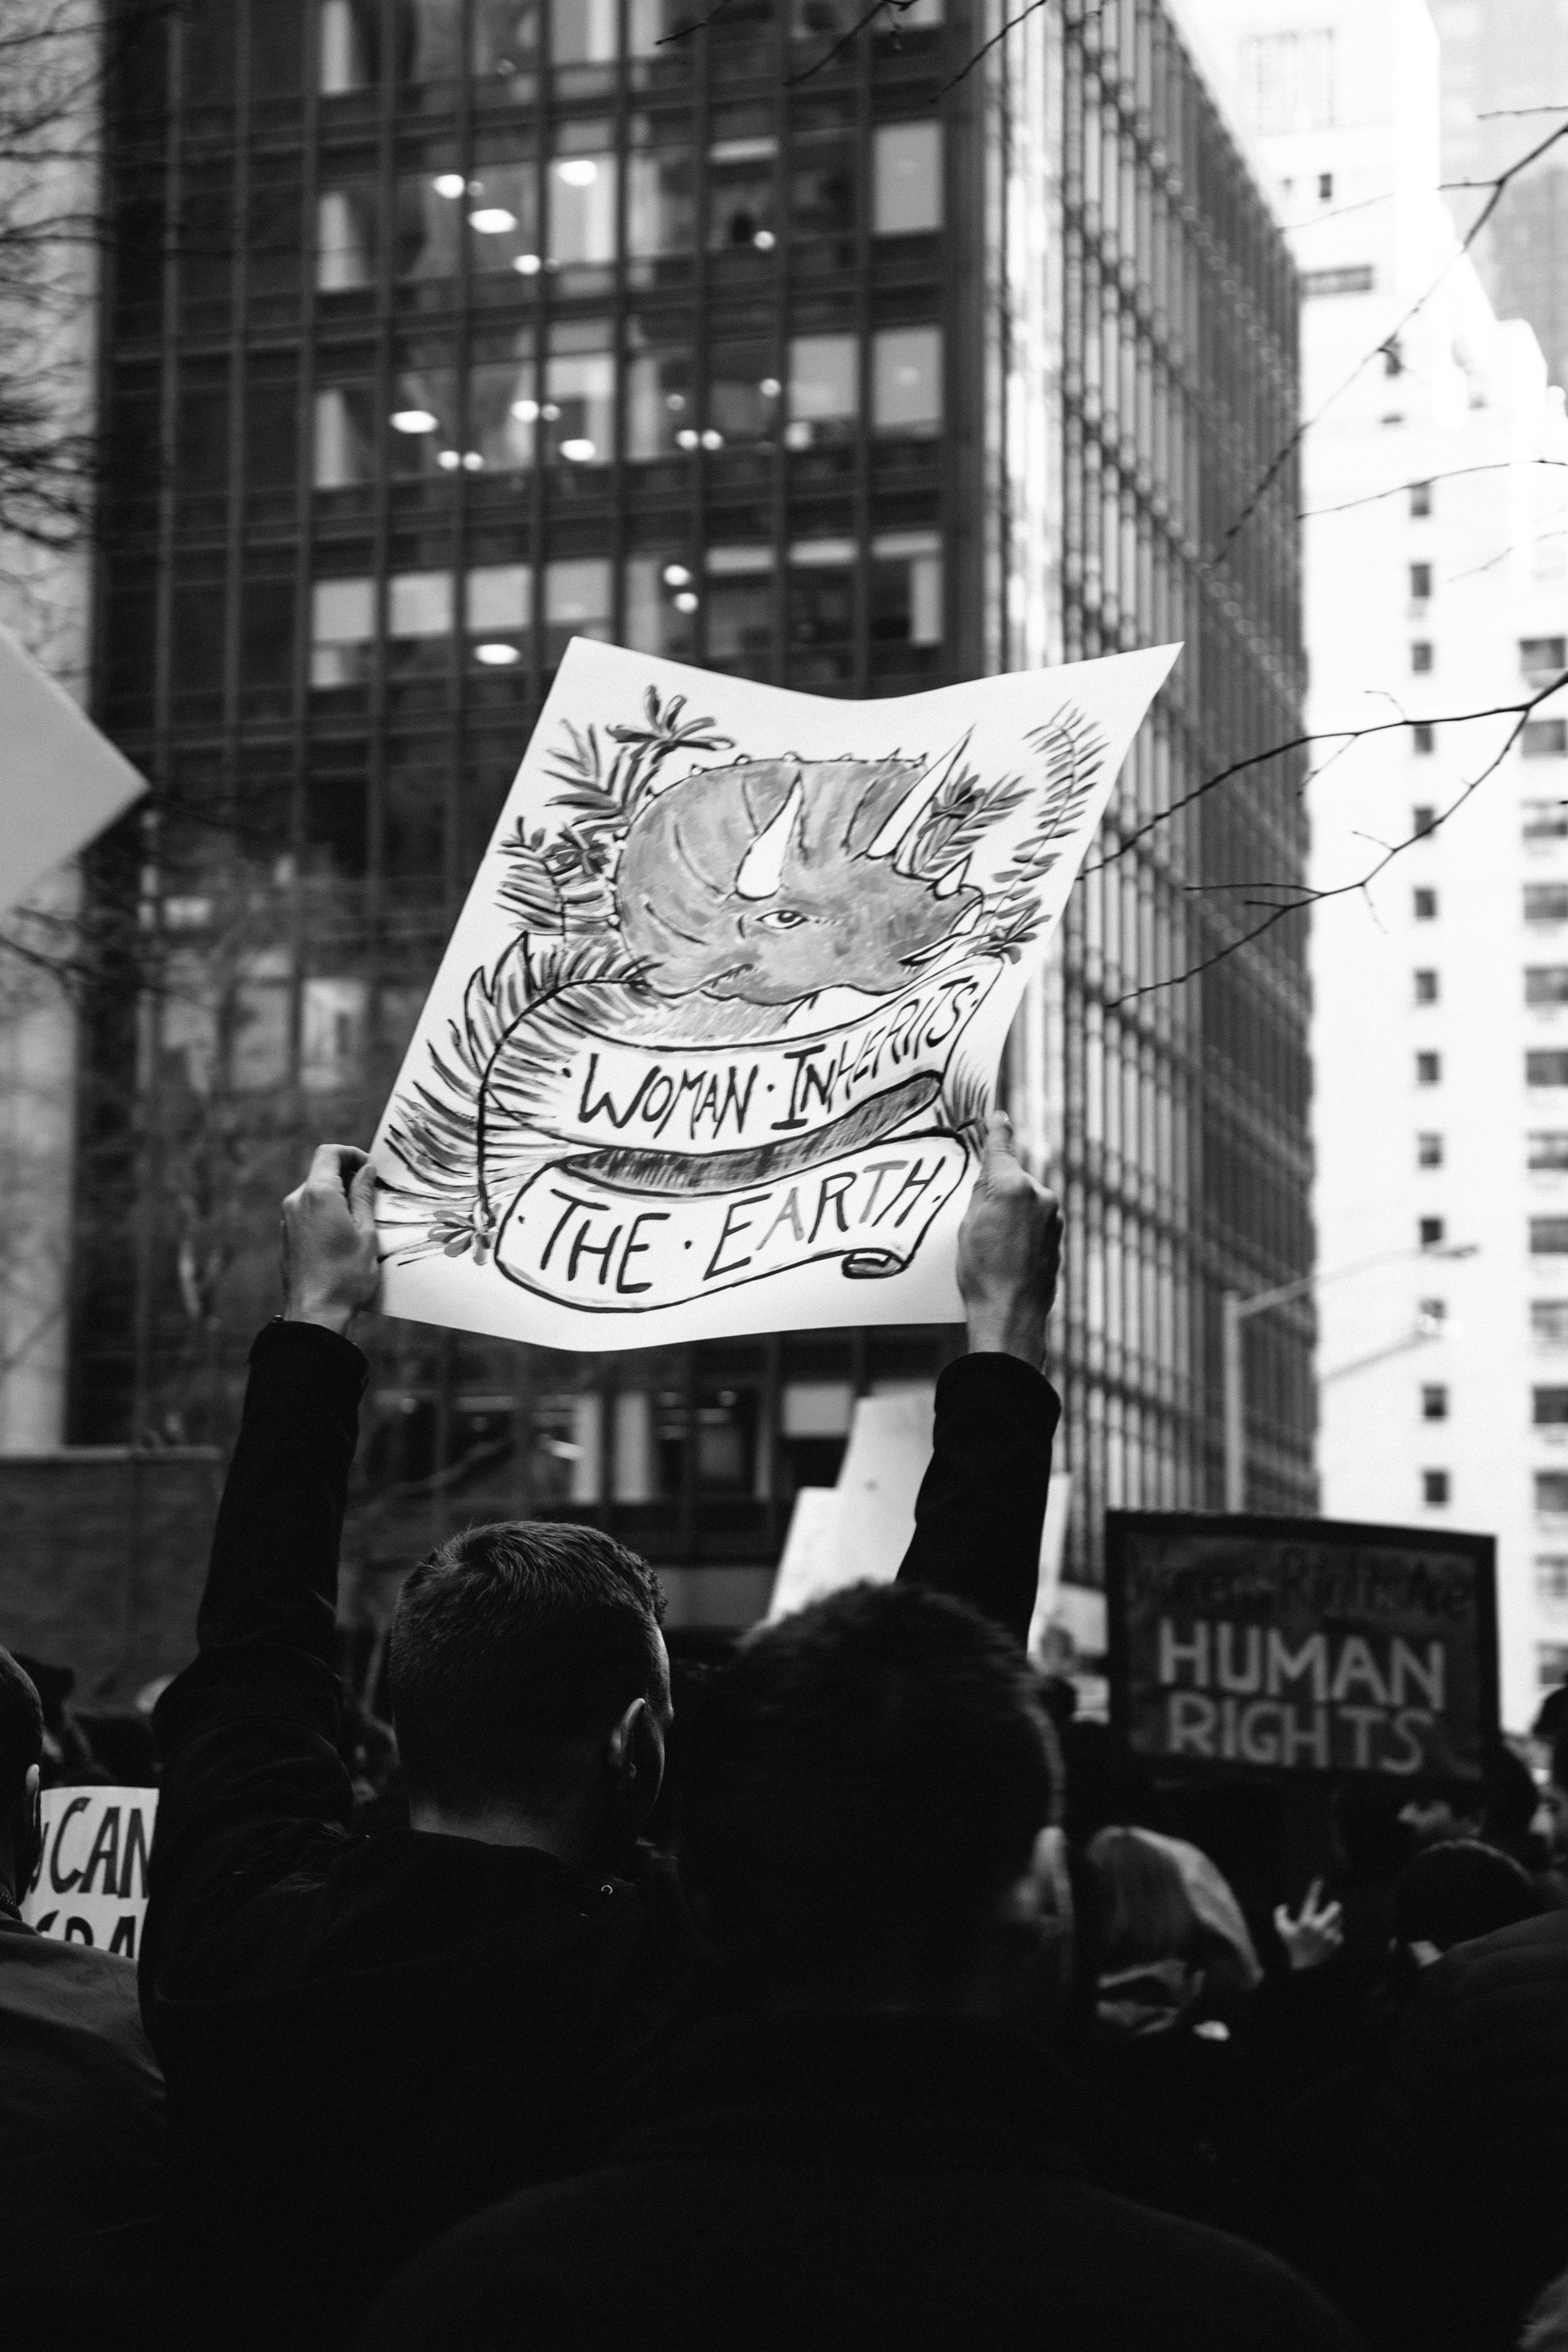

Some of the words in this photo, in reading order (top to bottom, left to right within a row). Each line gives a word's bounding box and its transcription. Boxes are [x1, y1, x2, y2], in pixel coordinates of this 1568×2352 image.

[578, 1052, 758, 1138] WOMAN
[771, 975, 979, 1130] INHERITS
[541, 1188, 671, 1293] THE
[703, 1155, 948, 1281] EARTH
[1159, 1616, 1443, 1712] HUMAN
[1167, 1692, 1435, 1775] RIGHTS
